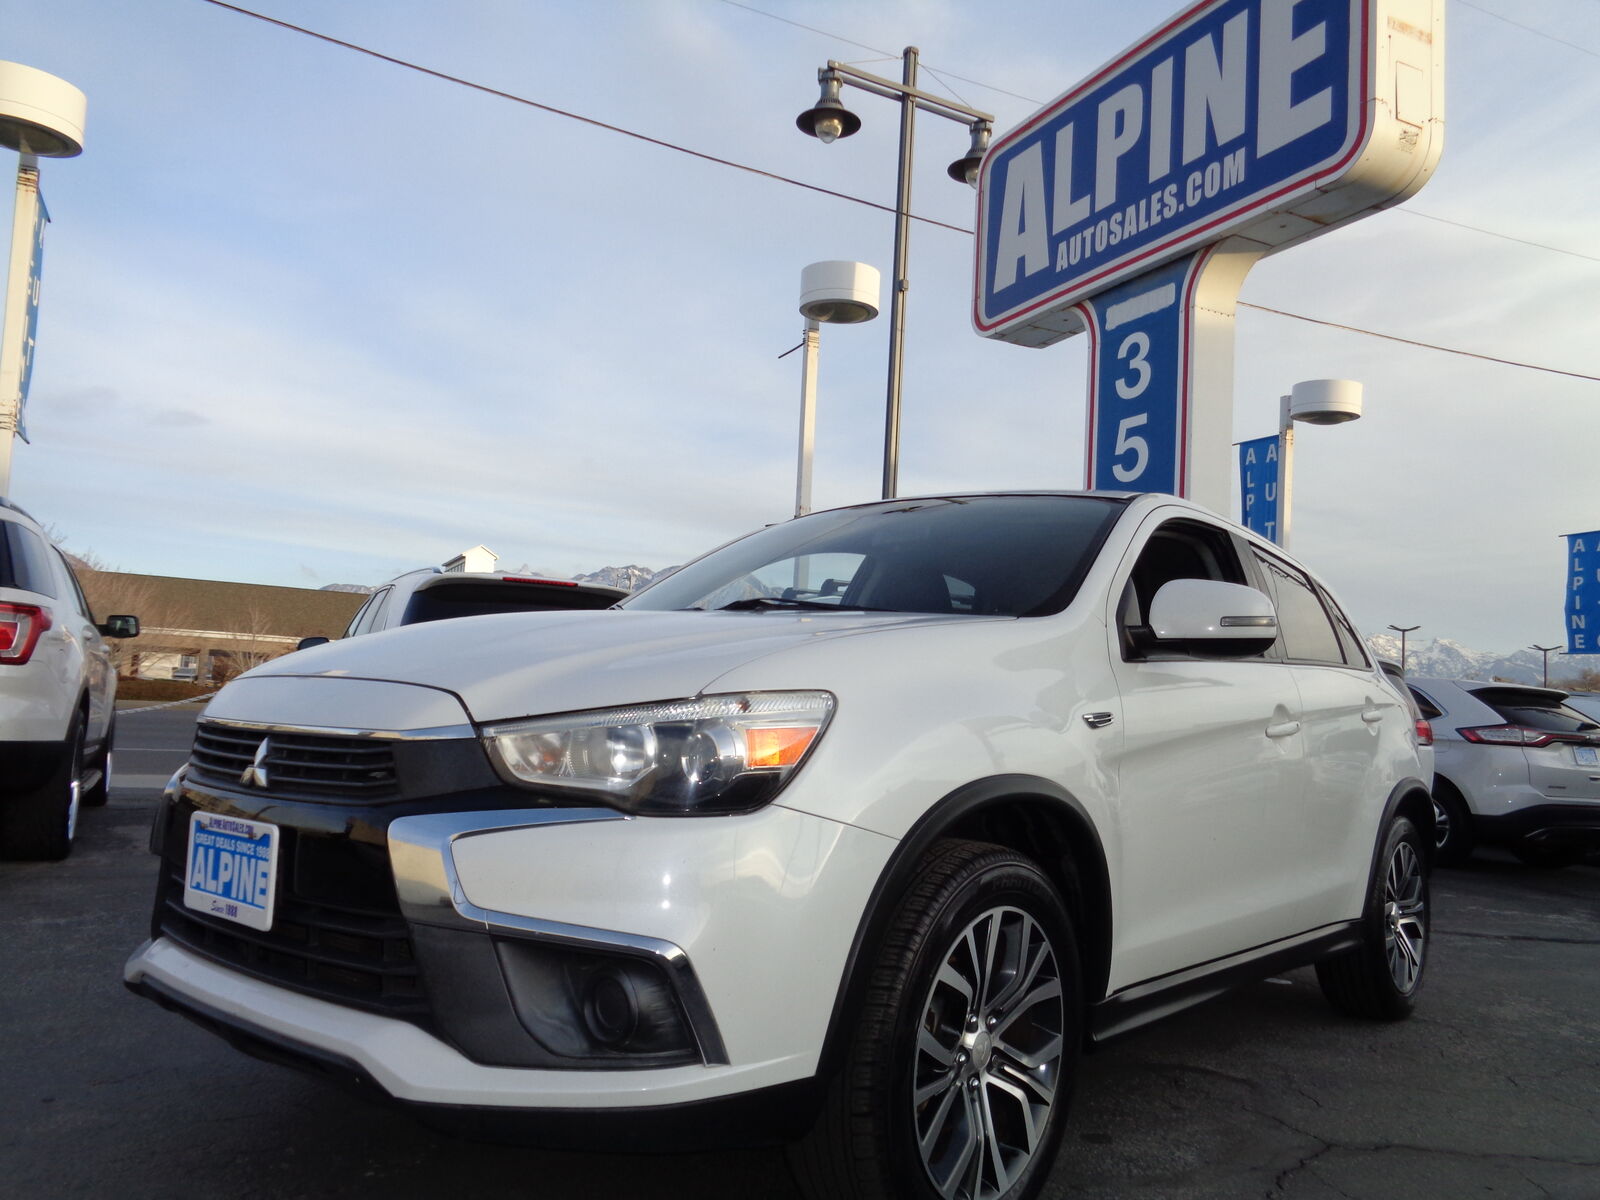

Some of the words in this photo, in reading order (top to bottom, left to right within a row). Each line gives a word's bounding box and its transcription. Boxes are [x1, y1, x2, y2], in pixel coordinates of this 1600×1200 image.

[993, 0, 1332, 294] ALPINE
[1055, 147, 1246, 273] AUTOSALES.COM
[1570, 539, 1585, 648] ALPINE
[191, 848, 269, 907] ALPINE
[215, 836, 236, 851] DEALS
[236, 840, 256, 856] SINCE
